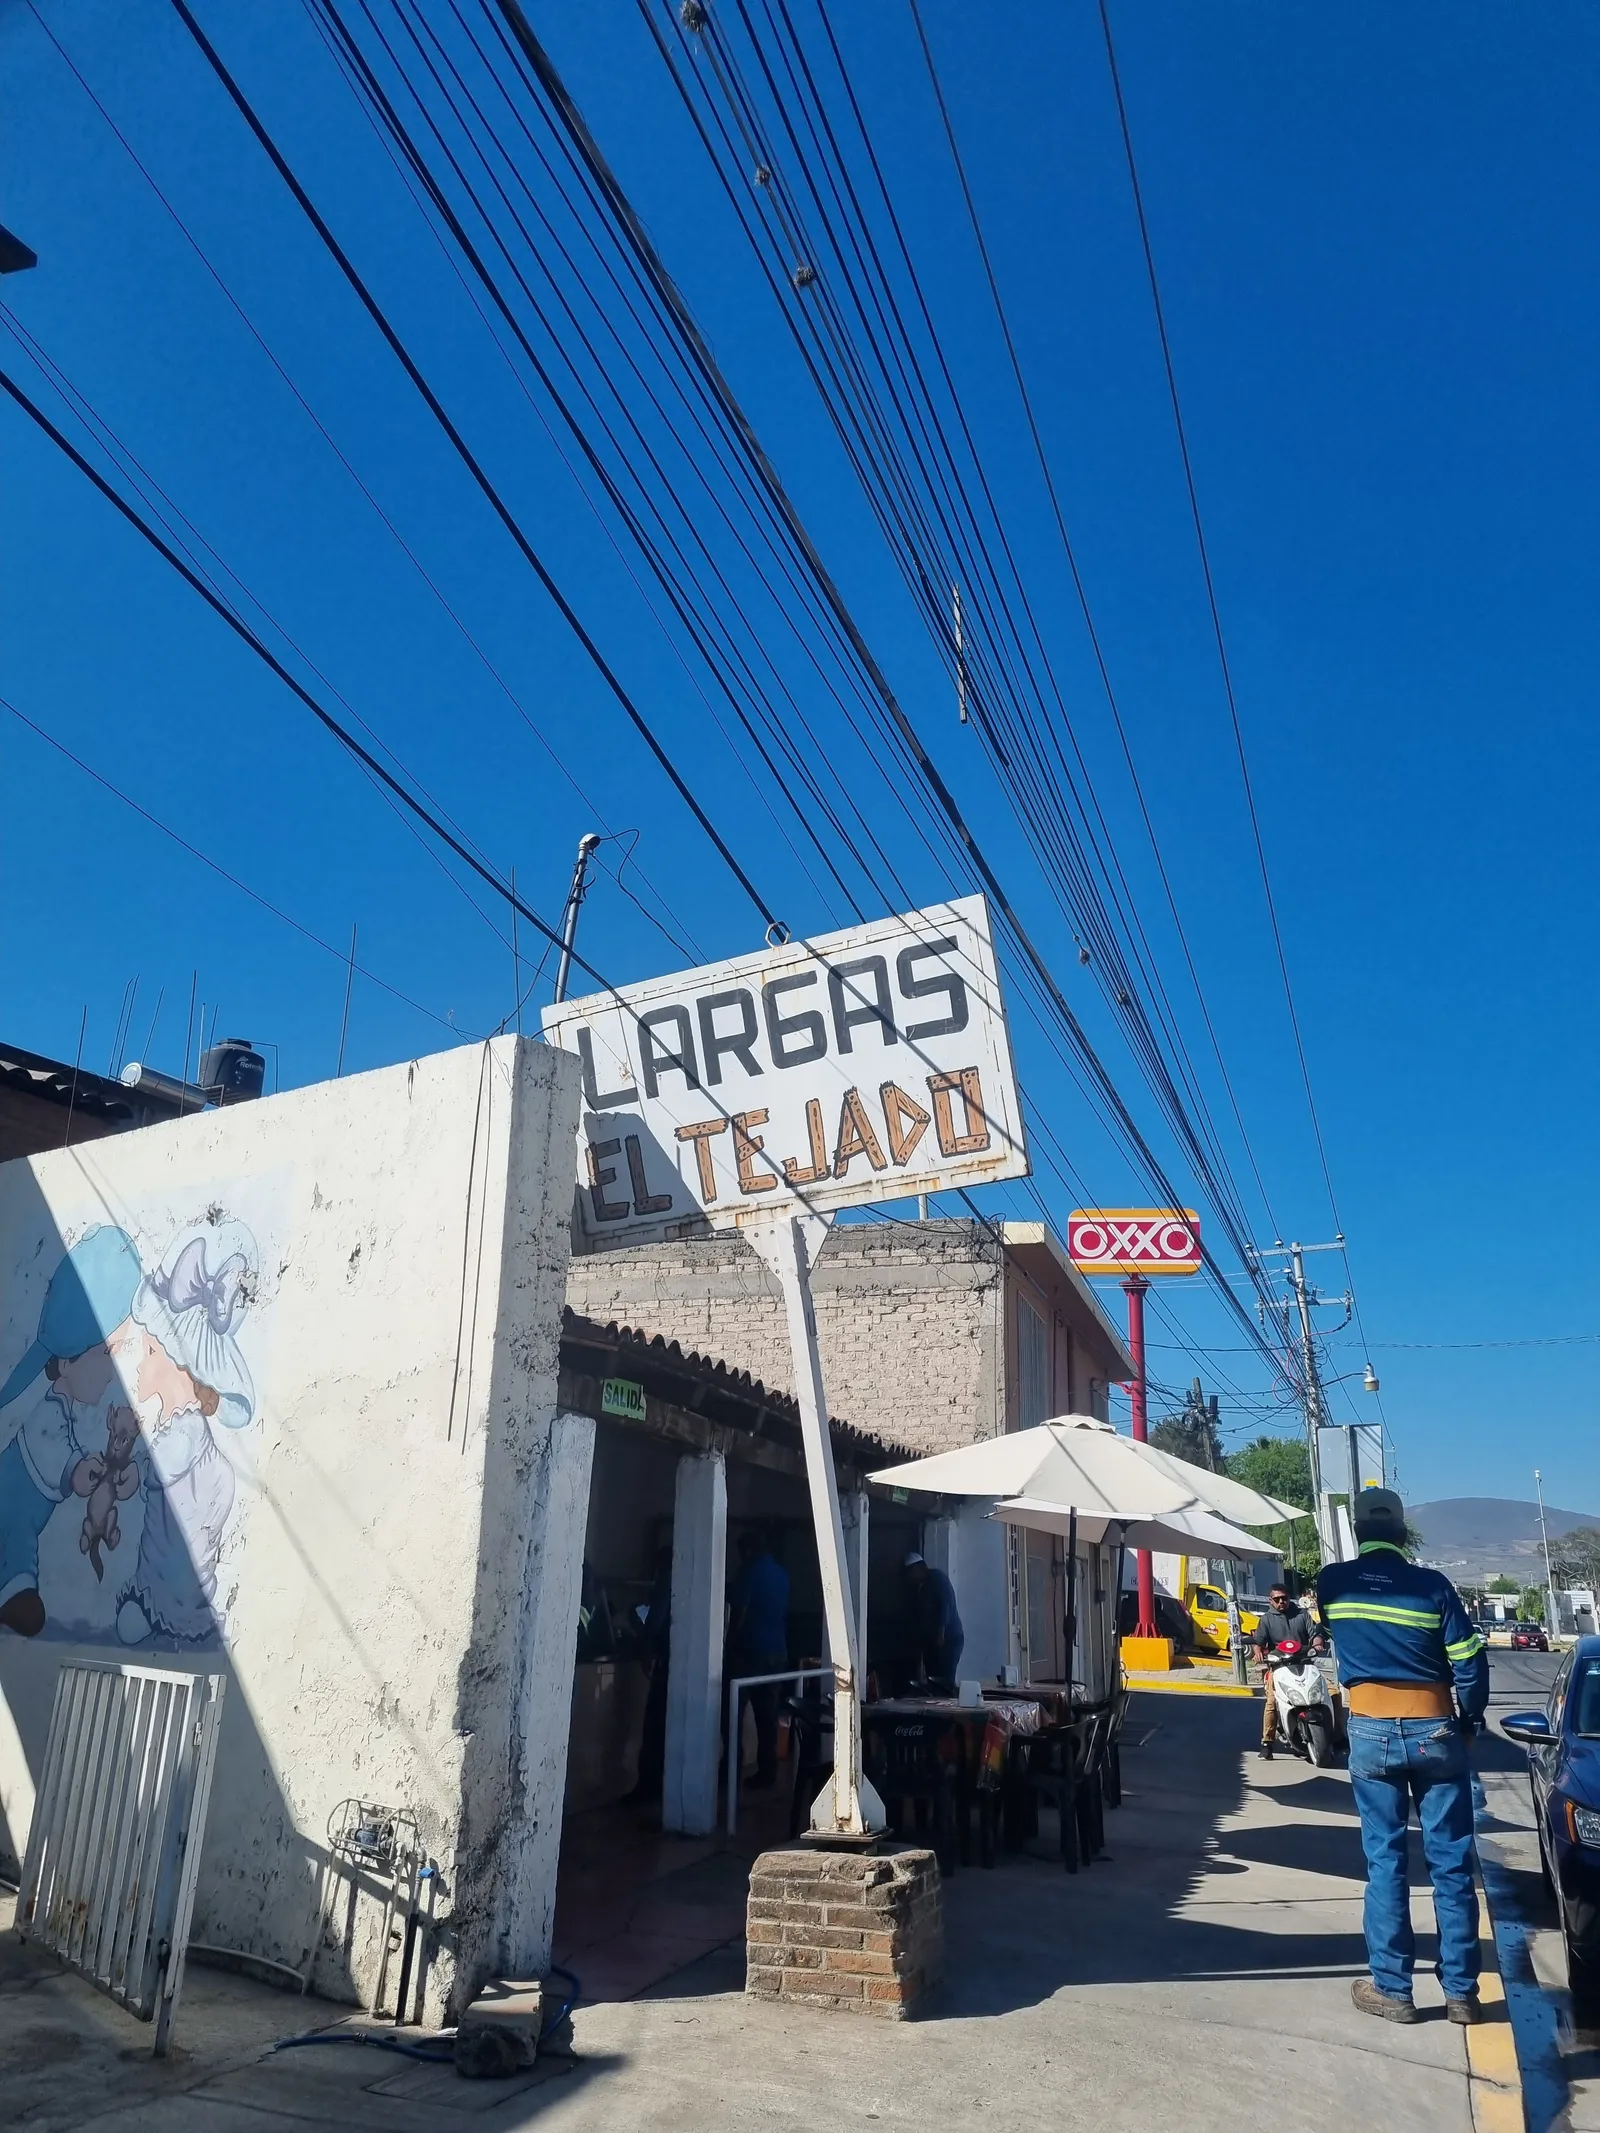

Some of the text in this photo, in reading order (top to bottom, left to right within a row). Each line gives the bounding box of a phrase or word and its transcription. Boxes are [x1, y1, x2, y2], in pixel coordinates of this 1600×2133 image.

[576, 935, 969, 1109] LARGAS
[586, 1065, 991, 1222] EL TEJADO
[1073, 1222, 1195, 1259] OXXO
